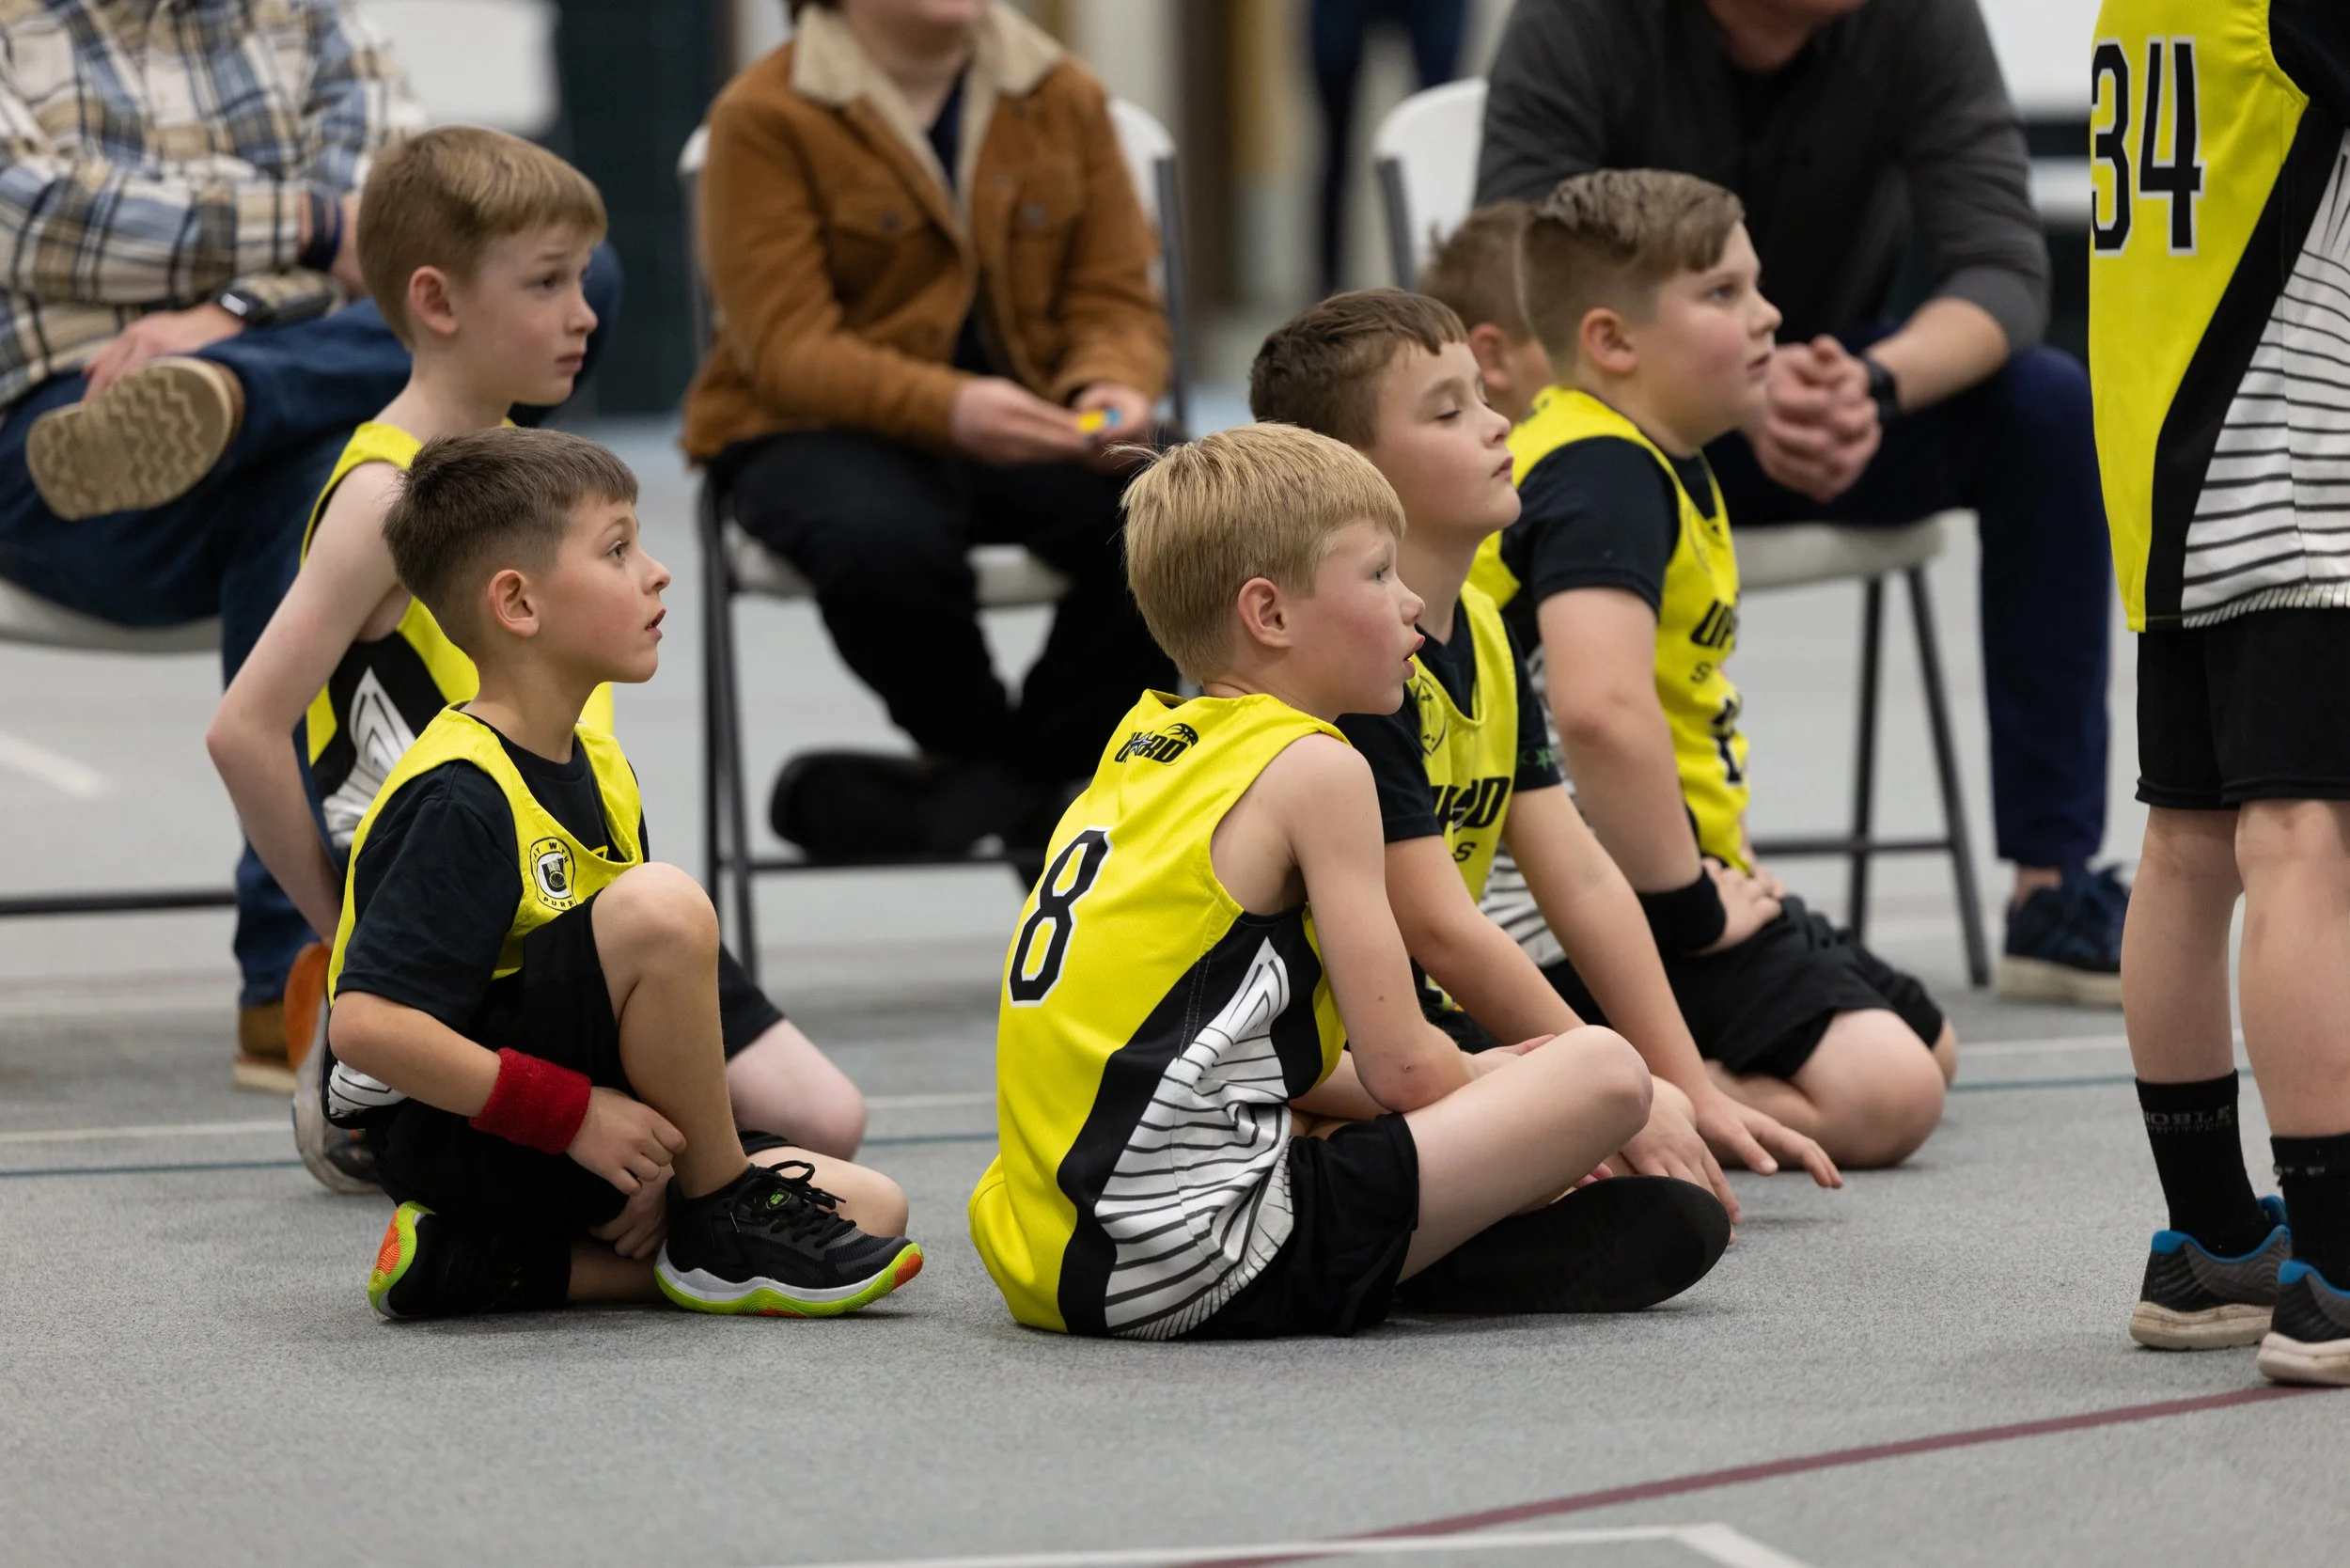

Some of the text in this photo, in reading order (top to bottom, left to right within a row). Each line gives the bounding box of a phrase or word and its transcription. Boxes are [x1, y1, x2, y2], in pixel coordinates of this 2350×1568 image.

[2090, 36, 2206, 257] 34
[543, 896, 574, 908] PURP
[1007, 826, 1114, 1008] 8
